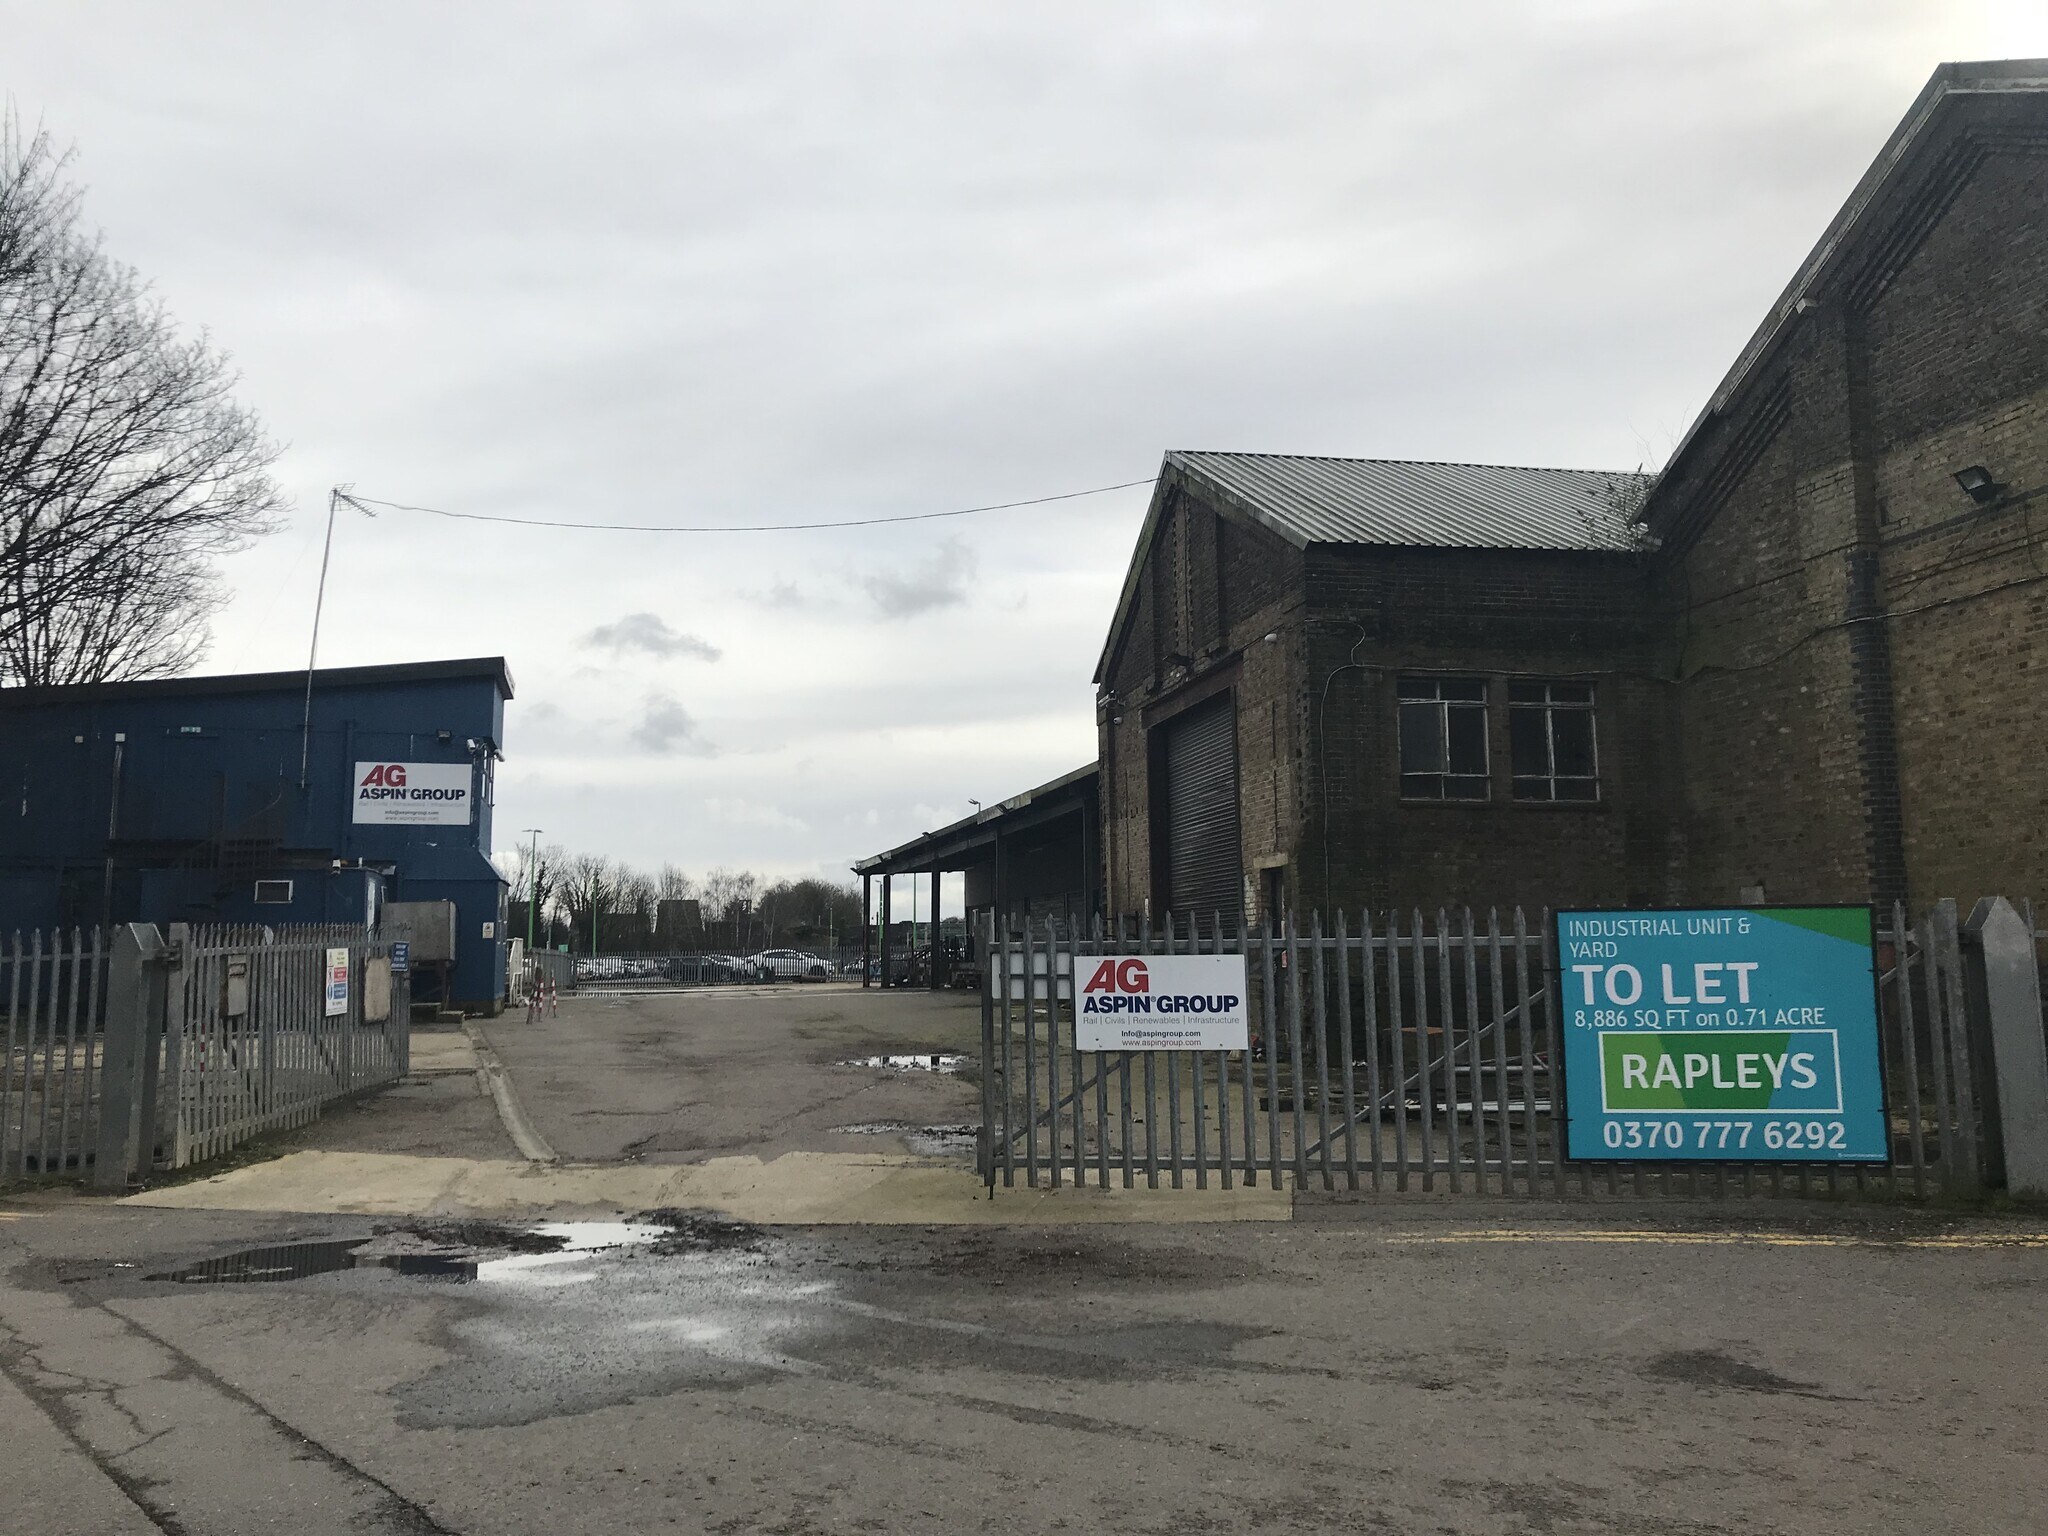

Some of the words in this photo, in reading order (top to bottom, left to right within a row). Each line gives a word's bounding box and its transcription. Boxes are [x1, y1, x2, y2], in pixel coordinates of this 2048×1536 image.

[360, 765, 406, 787] AG
[410, 788, 466, 800] GROUP
[1569, 919, 1682, 937] INDUSTRIAL
[1687, 918, 1733, 936] UNIT
[1738, 917, 1751, 934] &
[1570, 941, 1618, 958] YARD
[1083, 959, 1149, 994] AG
[1572, 963, 1643, 1006] TO
[1661, 962, 1759, 1005] LET
[1157, 995, 1239, 1013] GROUP
[1083, 1016, 1098, 1025] Rail
[1104, 1015, 1126, 1025] Civils
[1132, 1015, 1181, 1025] Renewables
[1187, 1015, 1240, 1025] Infrastructure
[1574, 1009, 1628, 1031] 8,886
[1633, 1009, 1662, 1030] SQ
[1666, 1009, 1691, 1028] FT
[1695, 1013, 1720, 1027] on
[1725, 1009, 1767, 1026] 0.71
[1774, 1007, 1826, 1025] ACRE
[1122, 1039, 1202, 1047] www.aspingroup.com
[1622, 1053, 1817, 1089] RAPLEYS
[1603, 1121, 1684, 1149] 0370
[1693, 1121, 1753, 1149] 777
[1763, 1121, 1847, 1149] 6292
